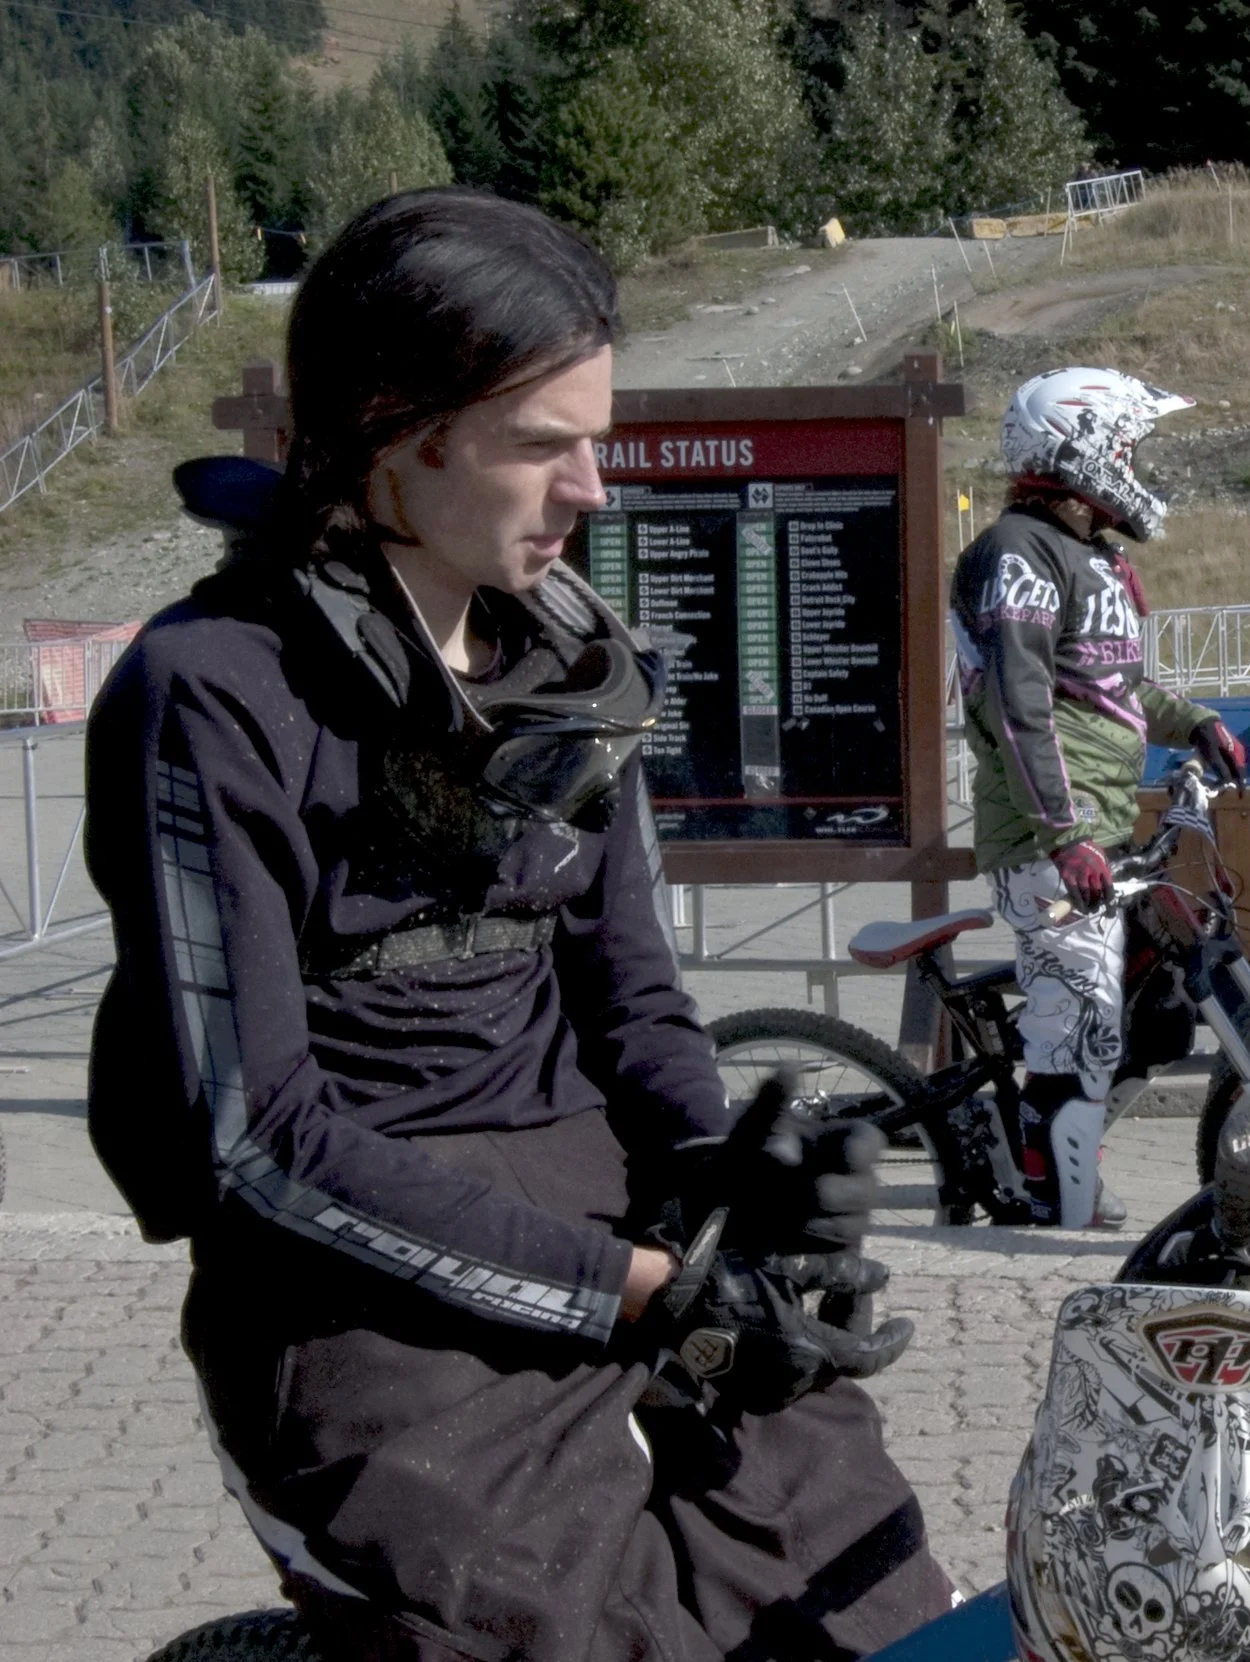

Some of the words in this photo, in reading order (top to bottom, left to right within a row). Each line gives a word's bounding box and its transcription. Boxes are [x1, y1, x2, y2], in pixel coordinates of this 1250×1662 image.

[594, 441, 653, 469] RAIL
[660, 438, 753, 468] STATUS
[600, 538, 621, 546] OPEN
[600, 550, 621, 558] OPEN
[600, 562, 621, 571] OPEN
[744, 560, 767, 569] OPEN
[600, 574, 621, 582] OPEN
[745, 573, 768, 582] OPEN
[600, 586, 621, 595] OPEN
[746, 584, 768, 594] OPEN
[746, 596, 768, 606] OPEN
[746, 609, 768, 618] OPEN
[746, 622, 768, 630] OPEN
[747, 634, 768, 643] OPEN
[748, 646, 769, 655] OPEN
[748, 658, 769, 667] OPEN
